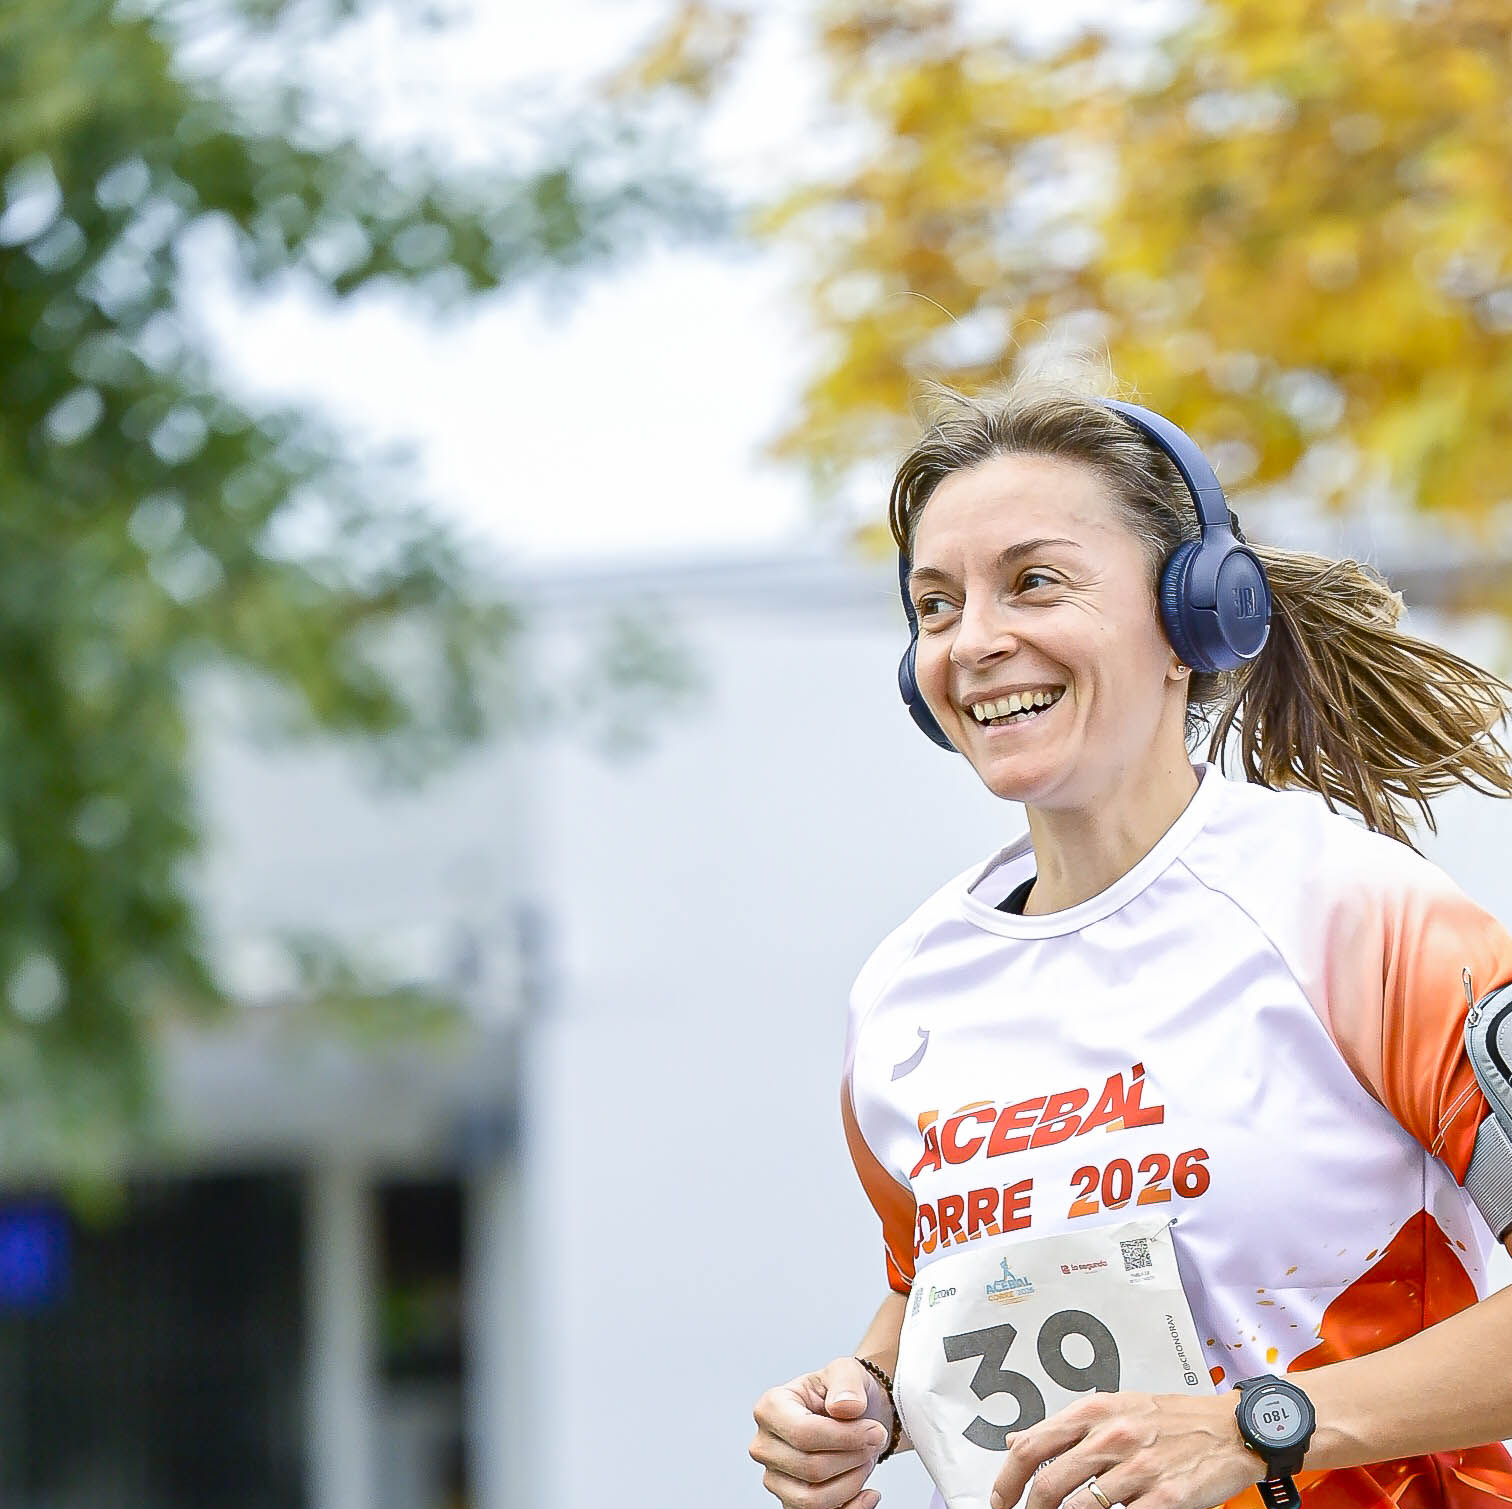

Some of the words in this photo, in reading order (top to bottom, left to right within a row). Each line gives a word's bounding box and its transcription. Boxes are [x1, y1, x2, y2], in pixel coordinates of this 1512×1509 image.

[909, 1062, 1164, 1179] ACEBAL
[913, 1178, 1033, 1259] ORRE
[1068, 1148, 1210, 1219] 2026
[986, 1276, 1032, 1295] ACEBAL
[943, 1309, 1121, 1452] 39
[1165, 1314, 1191, 1371] @CRONORAV
[1262, 1407, 1290, 1424] 180
